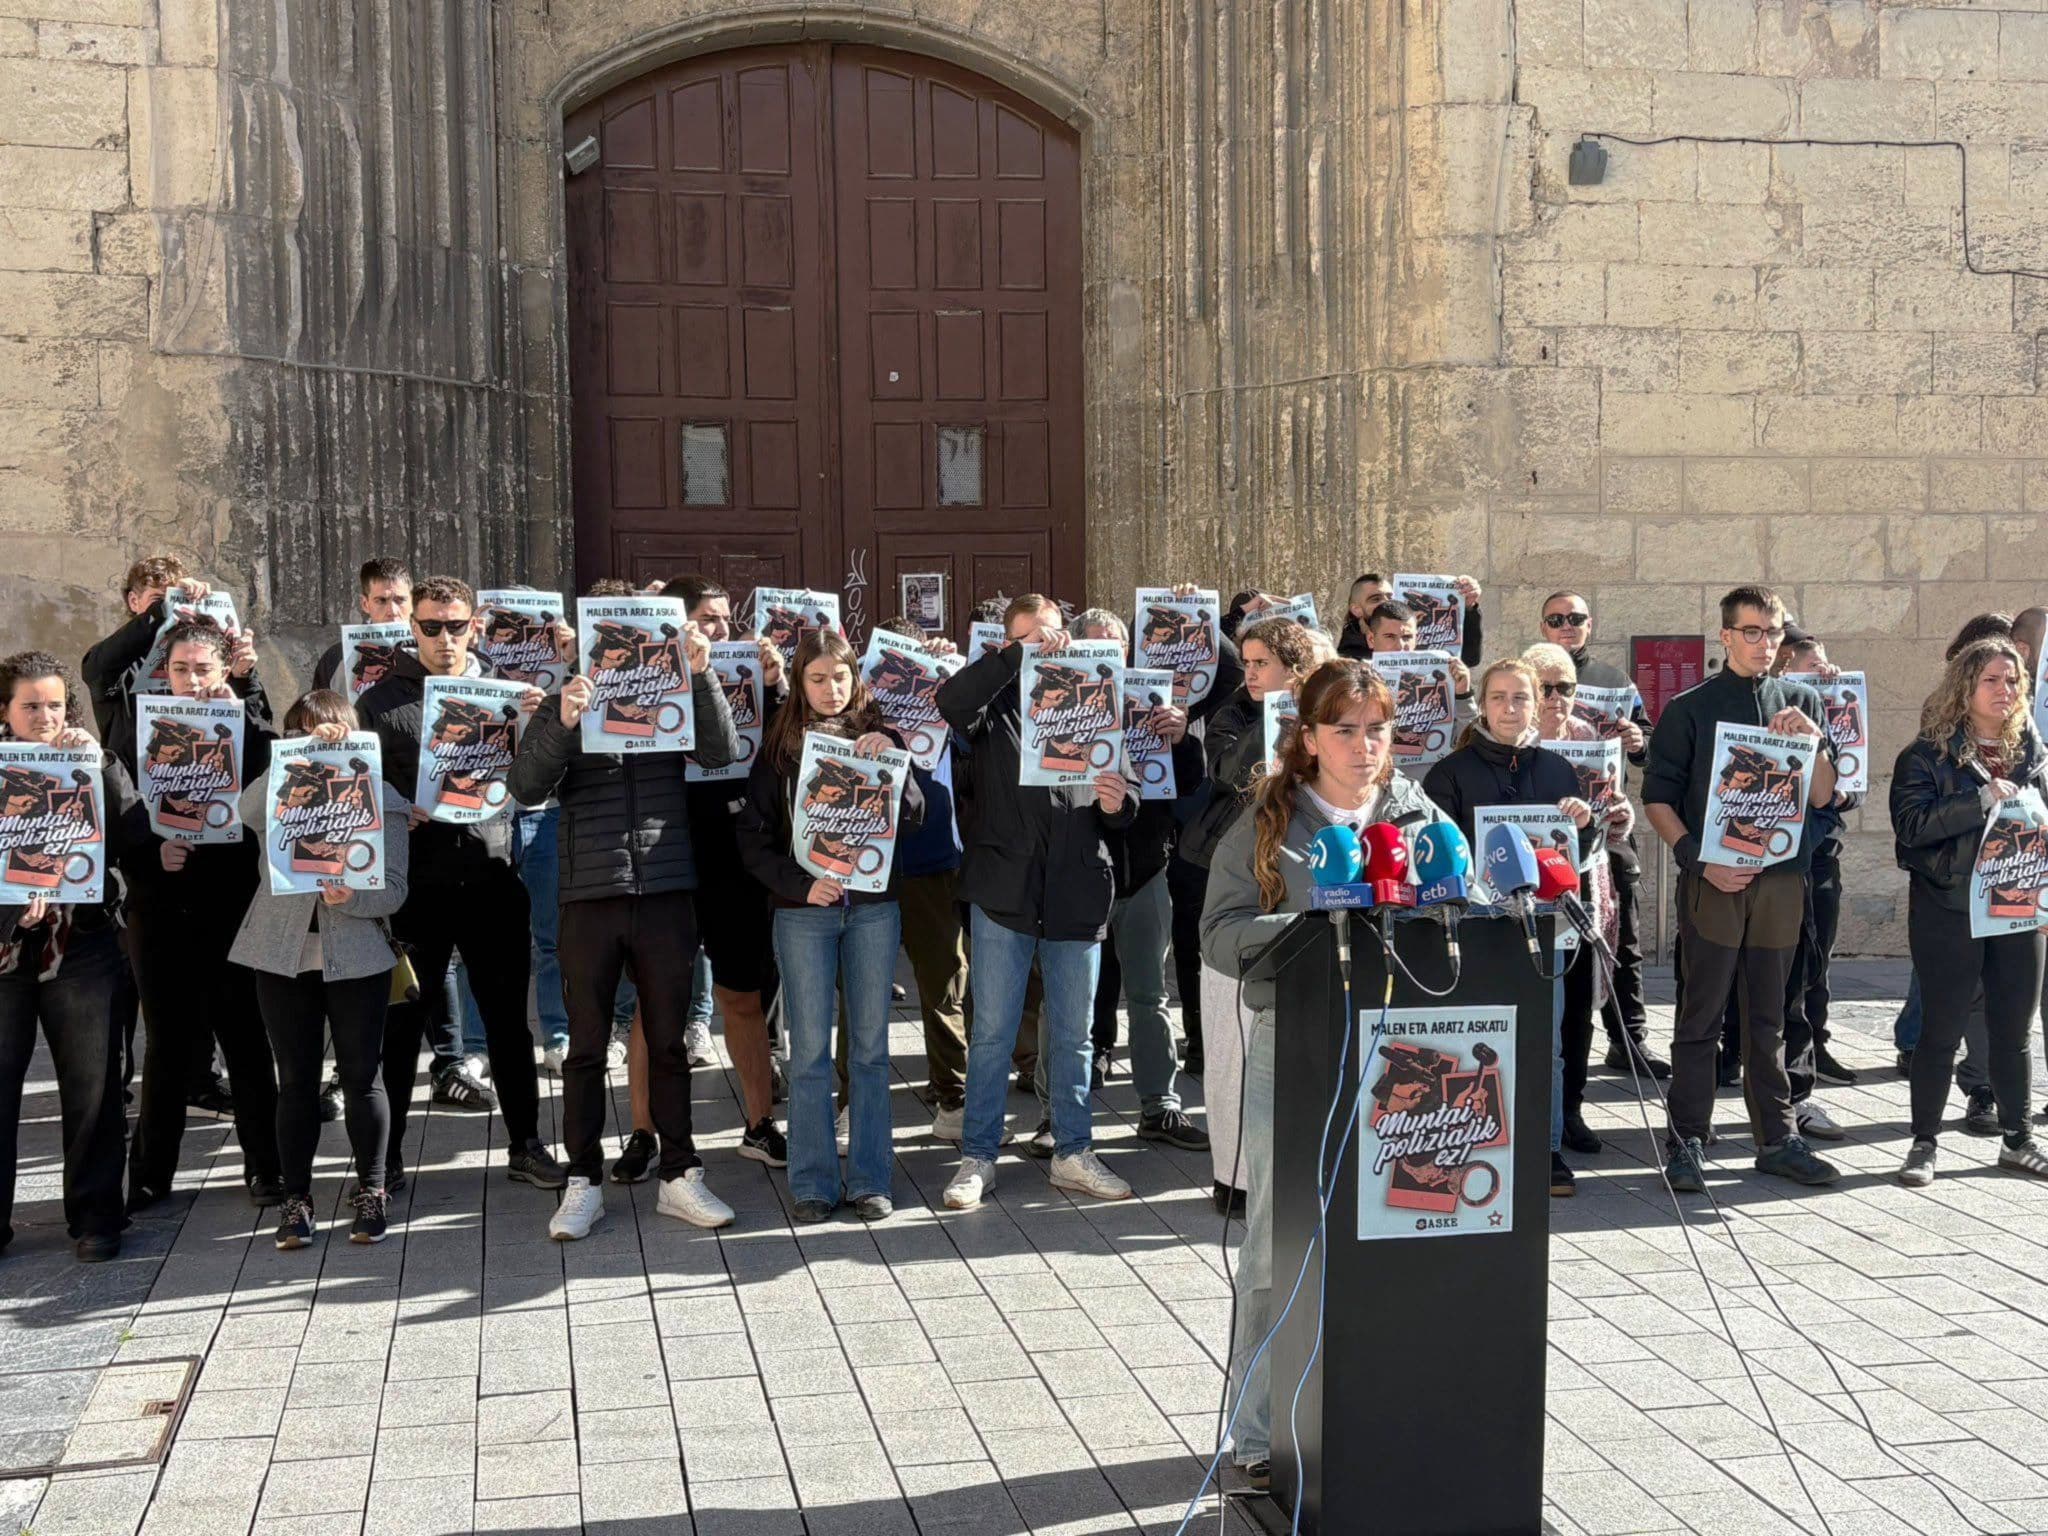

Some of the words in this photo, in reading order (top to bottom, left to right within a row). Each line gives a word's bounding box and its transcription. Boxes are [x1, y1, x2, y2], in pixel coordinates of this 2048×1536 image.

[586, 607, 612, 616] MALEN
[614, 607, 628, 616] ETA
[594, 661, 663, 686] Muntai
[433, 684, 458, 694] MALEN
[460, 686, 472, 695] ETA
[474, 688, 498, 698] ARATZ
[592, 672, 683, 711] polizialik
[145, 705, 169, 714] MALEN
[171, 706, 183, 715] ETA
[185, 707, 209, 716] ARATZ
[211, 709, 240, 718] ASKATU
[1033, 700, 1097, 725] Muntai
[1032, 711, 1114, 748] polizialik
[280, 748, 303, 757] MALEN
[304, 745, 315, 754] ETA
[317, 742, 342, 752] ARATZ
[344, 742, 375, 751] ASKATU
[433, 740, 499, 759] Muntai
[1724, 732, 1749, 743] MALEN
[1749, 735, 1761, 744] ETA
[1762, 736, 1785, 748] ARATZ
[1786, 739, 1813, 752] ASKATU
[0, 752, 19, 762] ALEN
[21, 752, 36, 762] ETA
[38, 752, 65, 762] ARATZ
[67, 753, 97, 763] ASKATU
[812, 743, 837, 754] MALEN
[876, 754, 905, 768] ASKATU
[149, 760, 214, 779] Muntai
[430, 751, 514, 781] polizialik
[150, 771, 233, 802] polizialik
[1720, 788, 1783, 804] Muntai
[280, 798, 353, 825] Muntai
[806, 802, 874, 820] Muntai
[1522, 815, 1544, 823] ARATZ
[1716, 801, 1798, 825] polizialik
[280, 808, 373, 851] polizialik
[803, 817, 888, 839] polizialik
[1543, 856, 1568, 867] rne
[1979, 846, 2039, 876] Muntai
[1979, 857, 2048, 898] poliziali
[2017, 872, 2041, 889] ez!
[1324, 888, 1350, 897] radio
[1324, 896, 1361, 905] euskadi
[1421, 884, 1447, 901] etb
[1371, 1022, 1407, 1036] MALEN
[1409, 1022, 1427, 1035] ETA
[1430, 1020, 1464, 1034] ARATZ
[1467, 1020, 1508, 1033] ASKATU
[1375, 1097, 1474, 1138] Muntai
[1373, 1114, 1499, 1175] polizialik
[1434, 1142, 1469, 1167] ez!
[1428, 1218, 1458, 1229] ASKE
